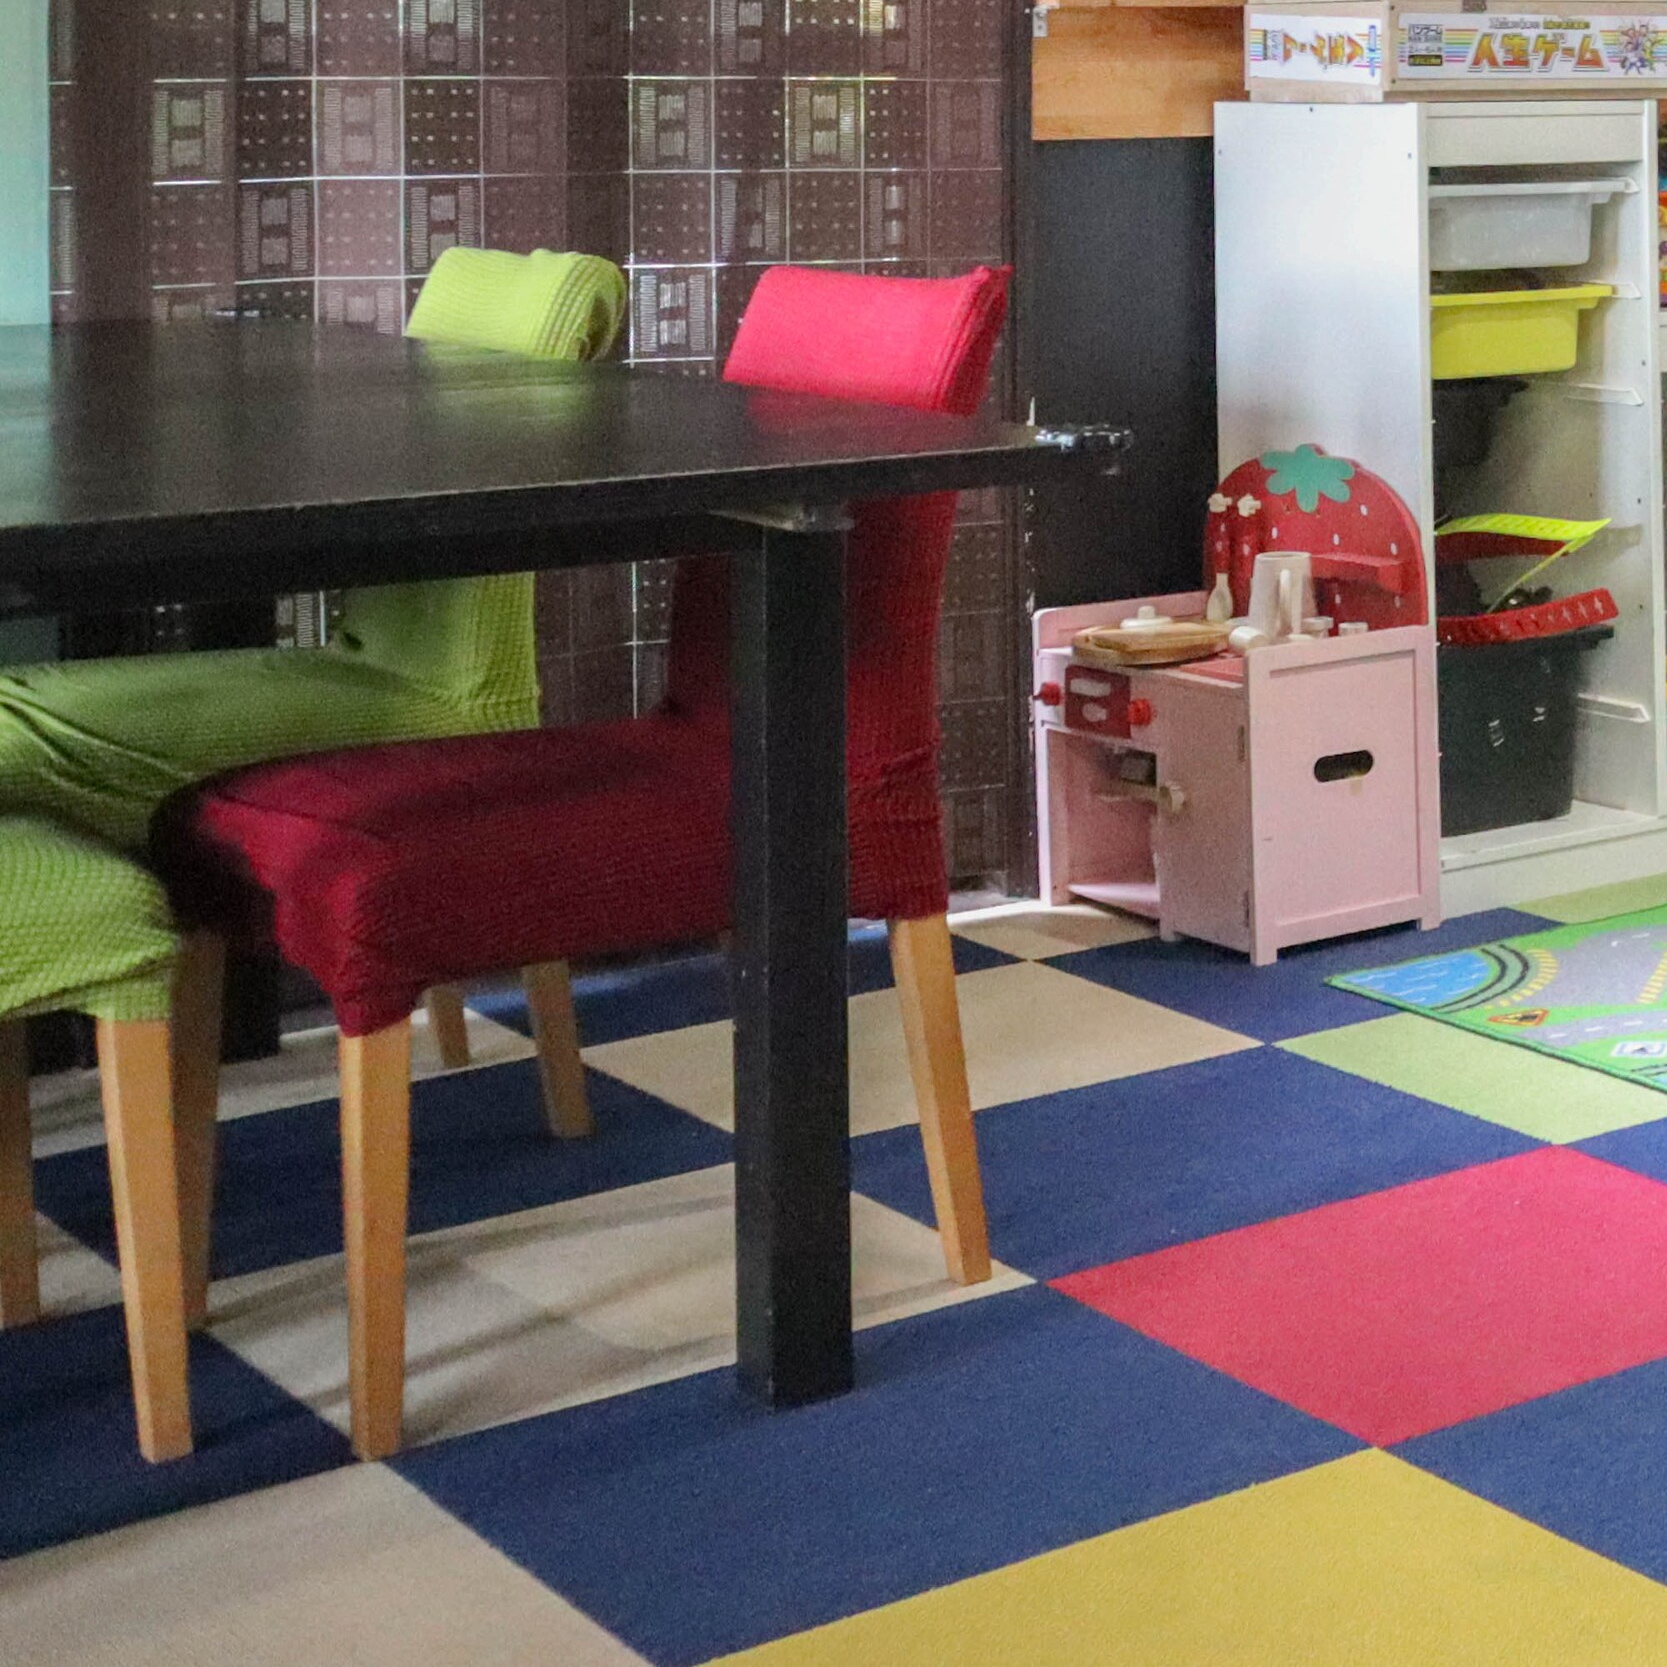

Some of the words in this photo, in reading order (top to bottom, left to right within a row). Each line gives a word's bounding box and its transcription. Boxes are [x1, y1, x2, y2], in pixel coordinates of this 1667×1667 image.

[1470, 32, 1607, 71] 人生ゲーム
